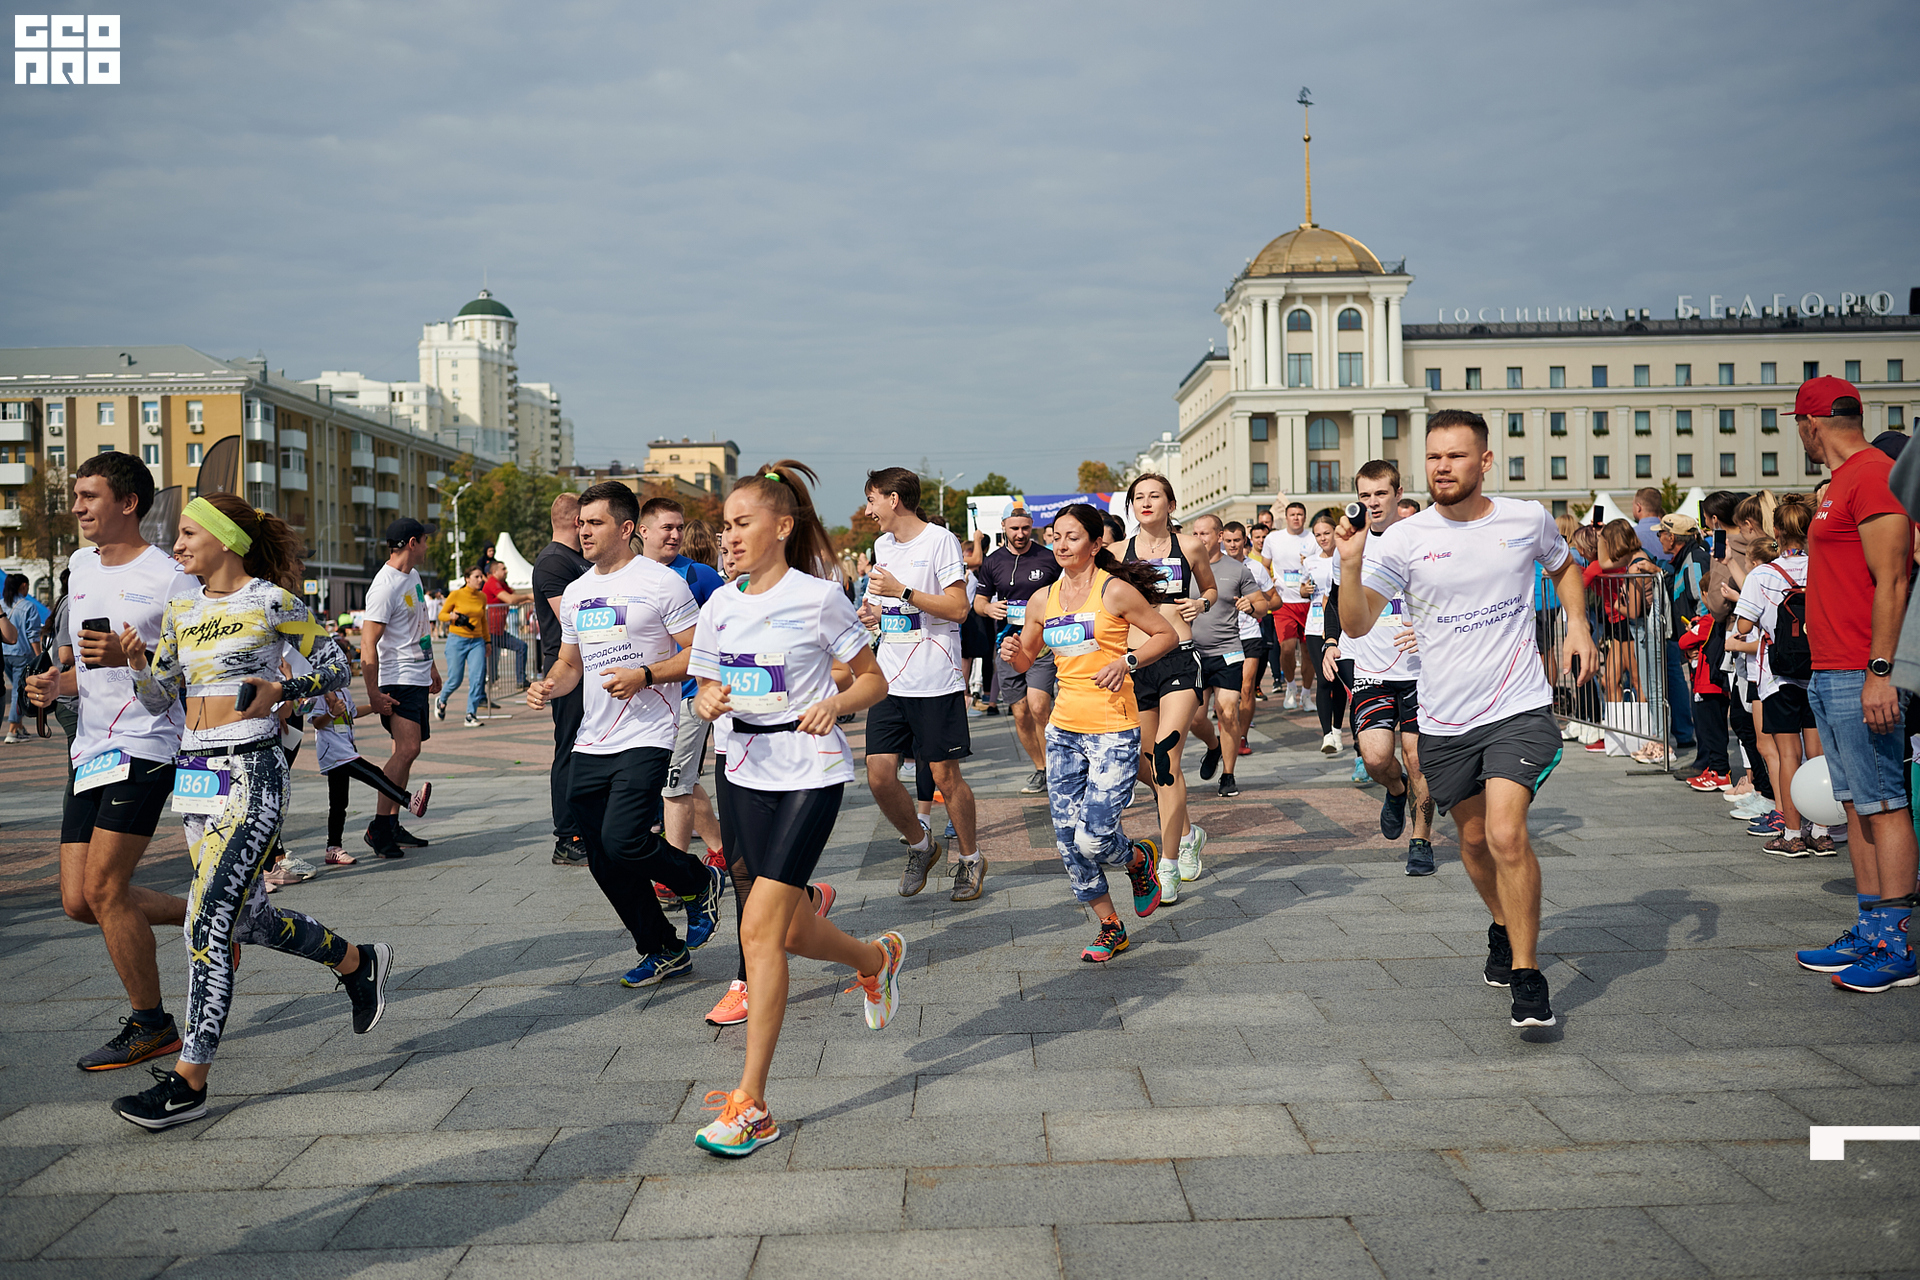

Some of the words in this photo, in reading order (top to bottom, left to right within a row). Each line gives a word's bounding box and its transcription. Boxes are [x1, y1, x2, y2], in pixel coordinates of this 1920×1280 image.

[1438, 305, 1615, 324] ГОСТИНИЦА
[1677, 290, 1895, 319] БЕЛГОРО
[1011, 607, 1026, 616] 109
[1437, 593, 1523, 624] БЕЛГОРОДСКИЙ
[1454, 602, 1530, 634] ПОЛУМАРАФОН
[180, 617, 222, 641] TRAIN
[581, 611, 611, 629] 1355
[884, 617, 907, 631] 1229
[196, 622, 244, 648] HARD
[1050, 626, 1081, 645] 1045
[583, 642, 632, 663] ГОРОДСКИЙ
[725, 671, 760, 692] 1451
[81, 751, 114, 776] 1323
[178, 773, 211, 794] 1361
[199, 899, 236, 1041] DOMINATION
[223, 786, 281, 898] MACHINE
